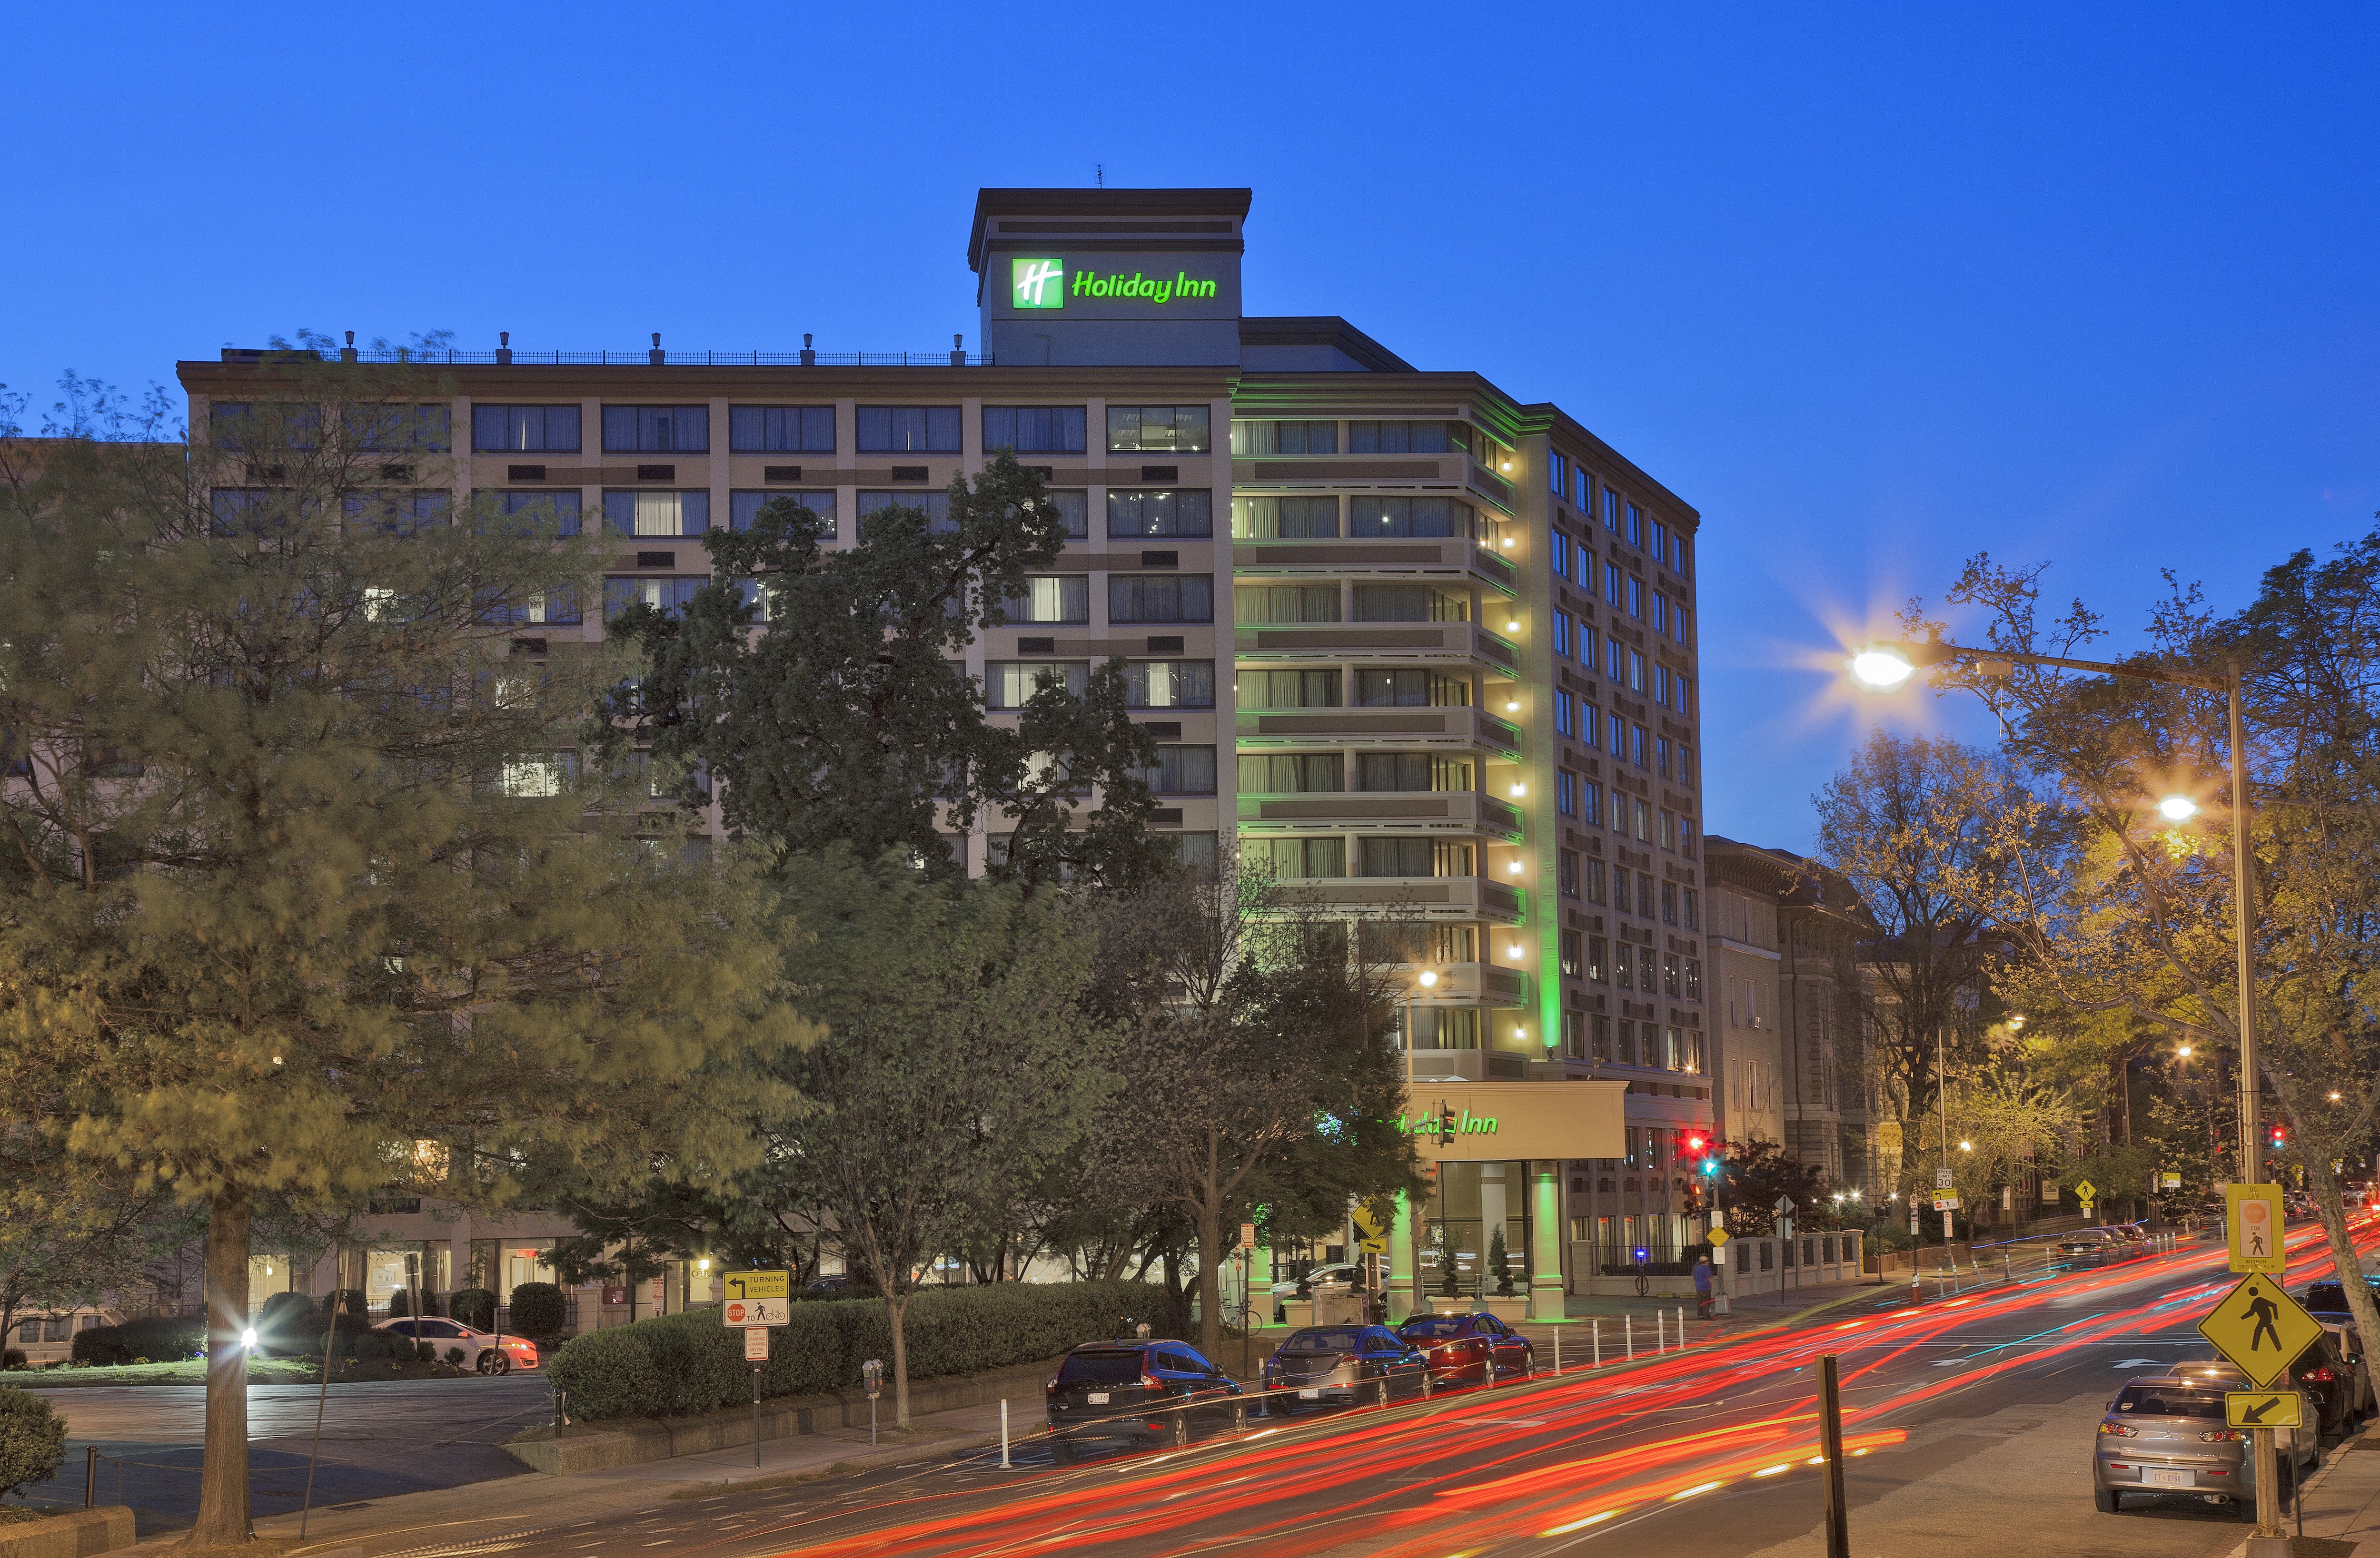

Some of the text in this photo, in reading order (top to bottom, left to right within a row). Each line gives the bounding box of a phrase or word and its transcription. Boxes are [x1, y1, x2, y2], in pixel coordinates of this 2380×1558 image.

[1072, 271, 1216, 303] Holiday Inn
[1460, 1110, 1497, 1134] Inn
[728, 1309, 744, 1317] STOP
